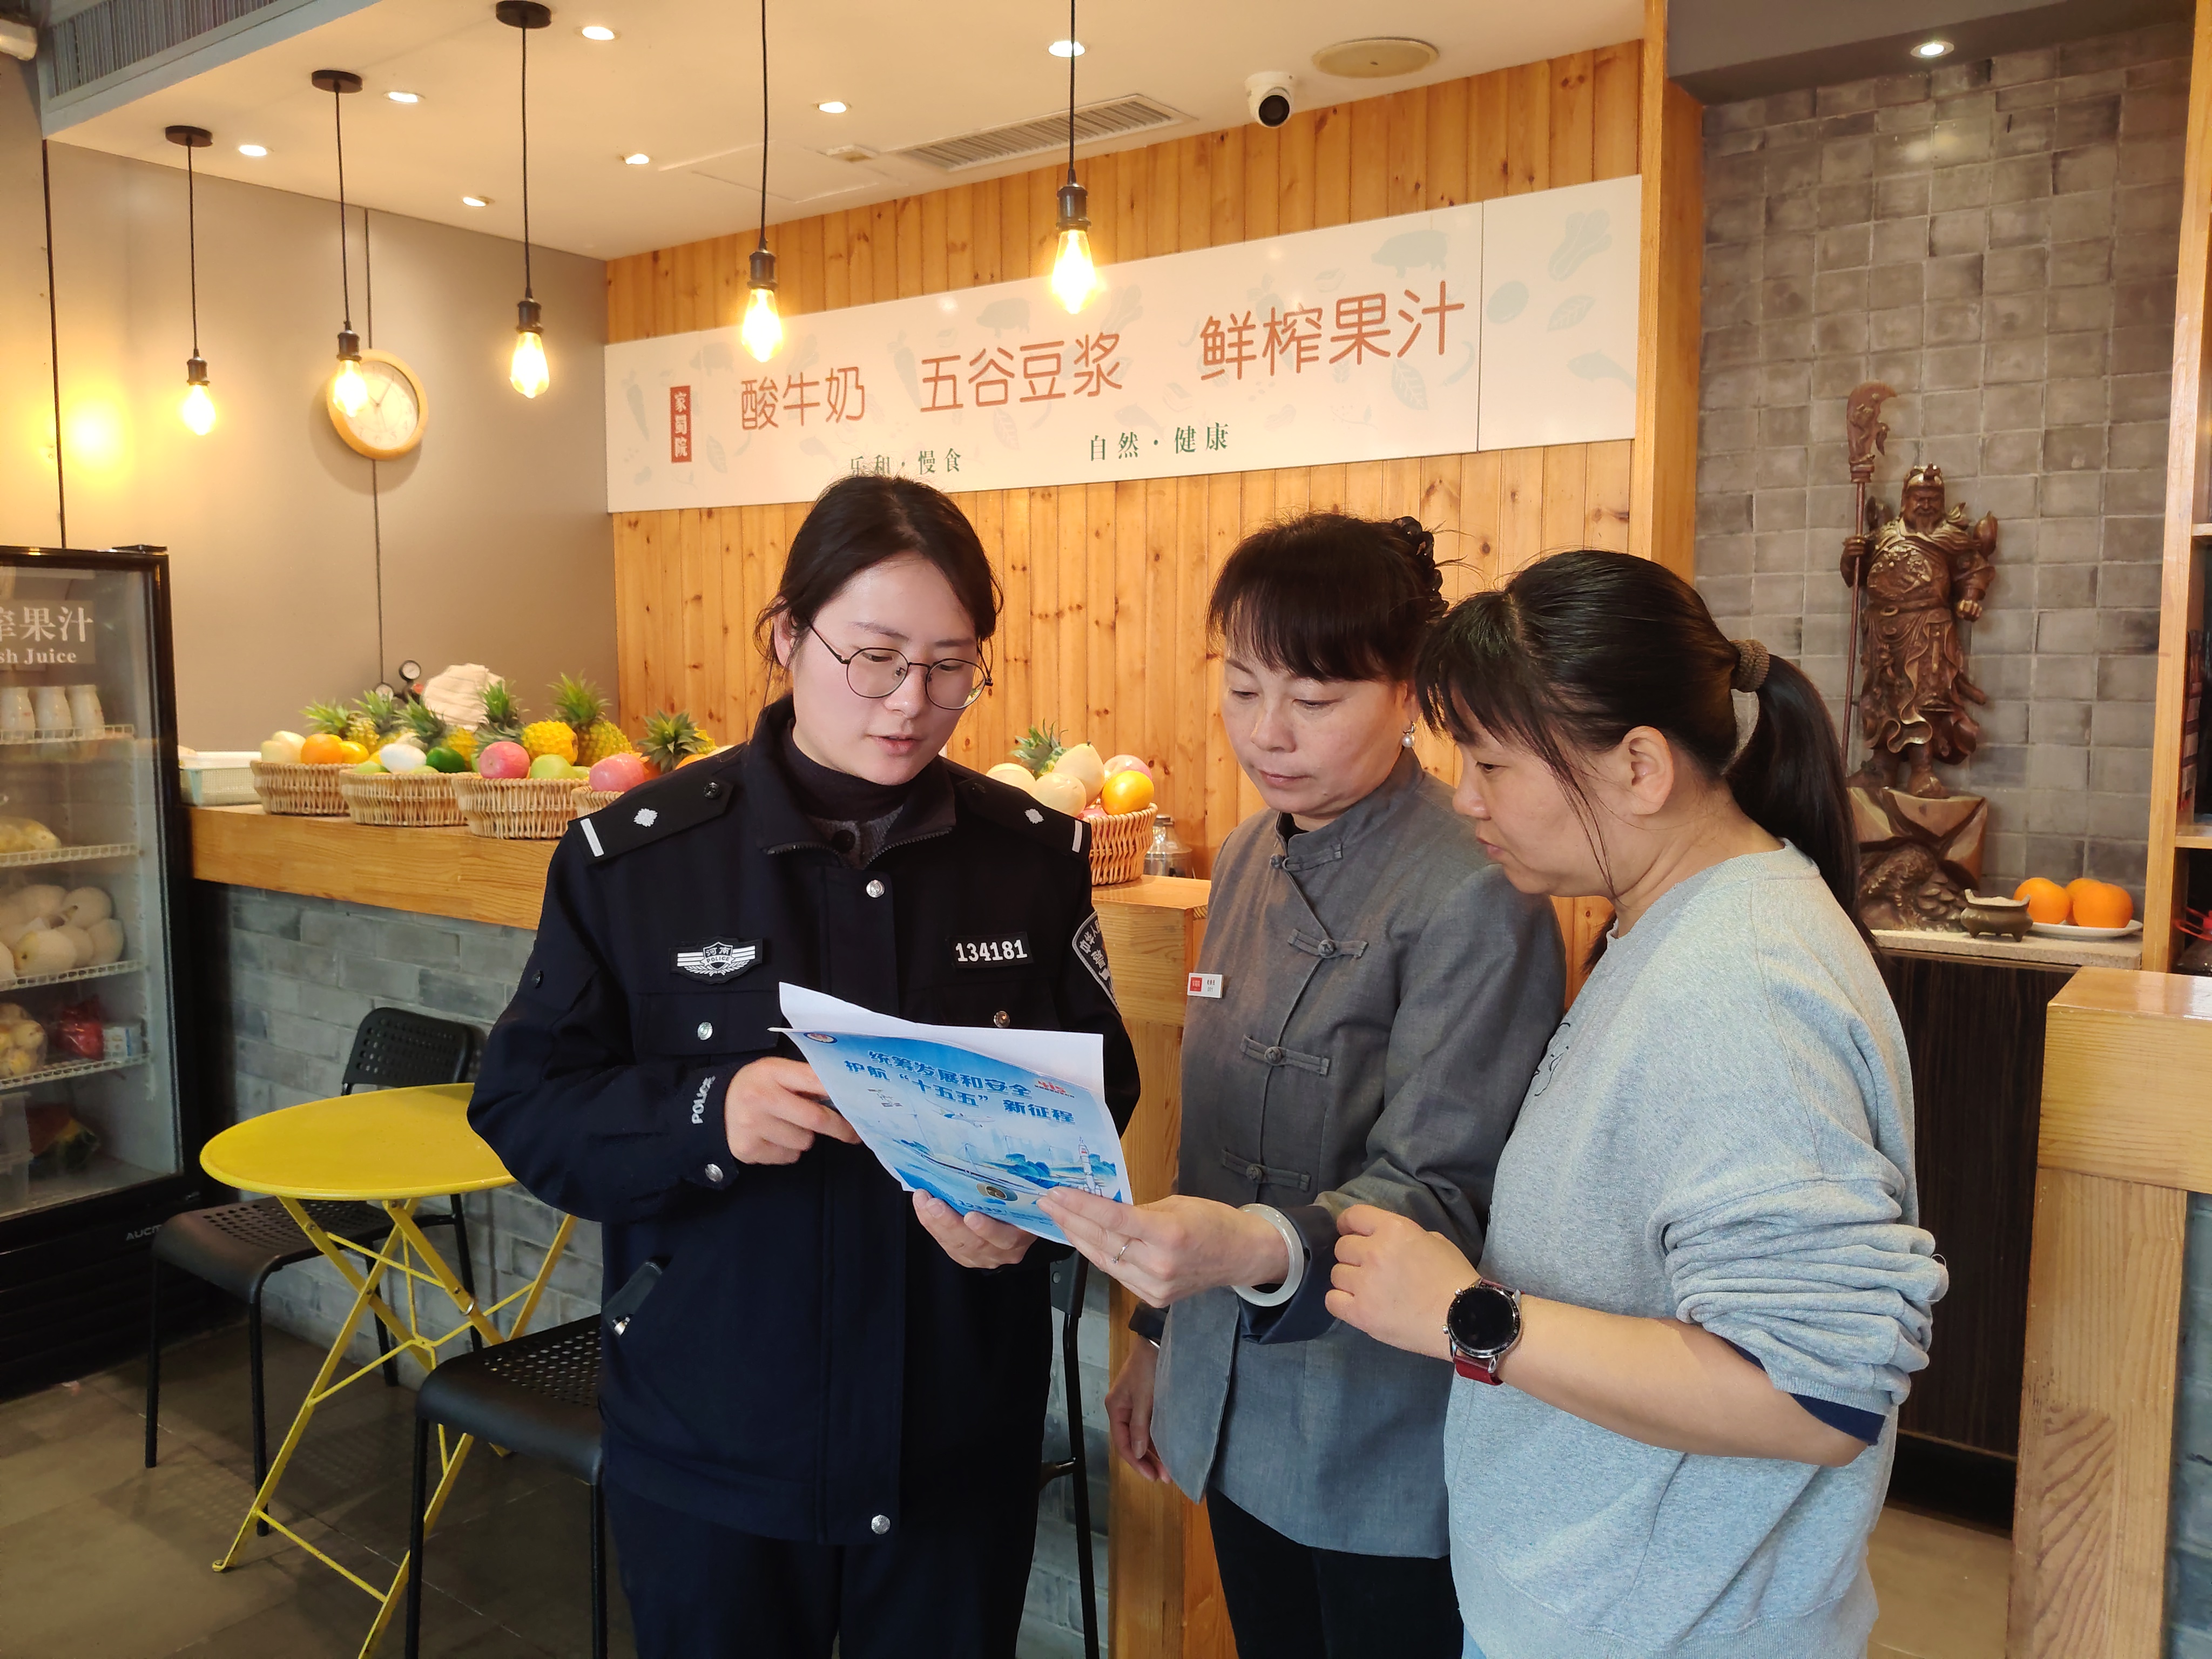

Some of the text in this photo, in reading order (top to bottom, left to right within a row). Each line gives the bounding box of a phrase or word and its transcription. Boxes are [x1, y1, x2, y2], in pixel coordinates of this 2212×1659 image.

[740, 279, 1466, 430] 酸牛奶 五谷豆浆 鲜榨果汁
[1089, 421, 1230, 462] 自然·健康
[24, 648, 77, 665] Juice
[705, 947, 731, 956] 河南
[955, 939, 1028, 962] 134181
[868, 1050, 1033, 1099] 统筹发展和安全
[691, 1075, 716, 1124] POLICE
